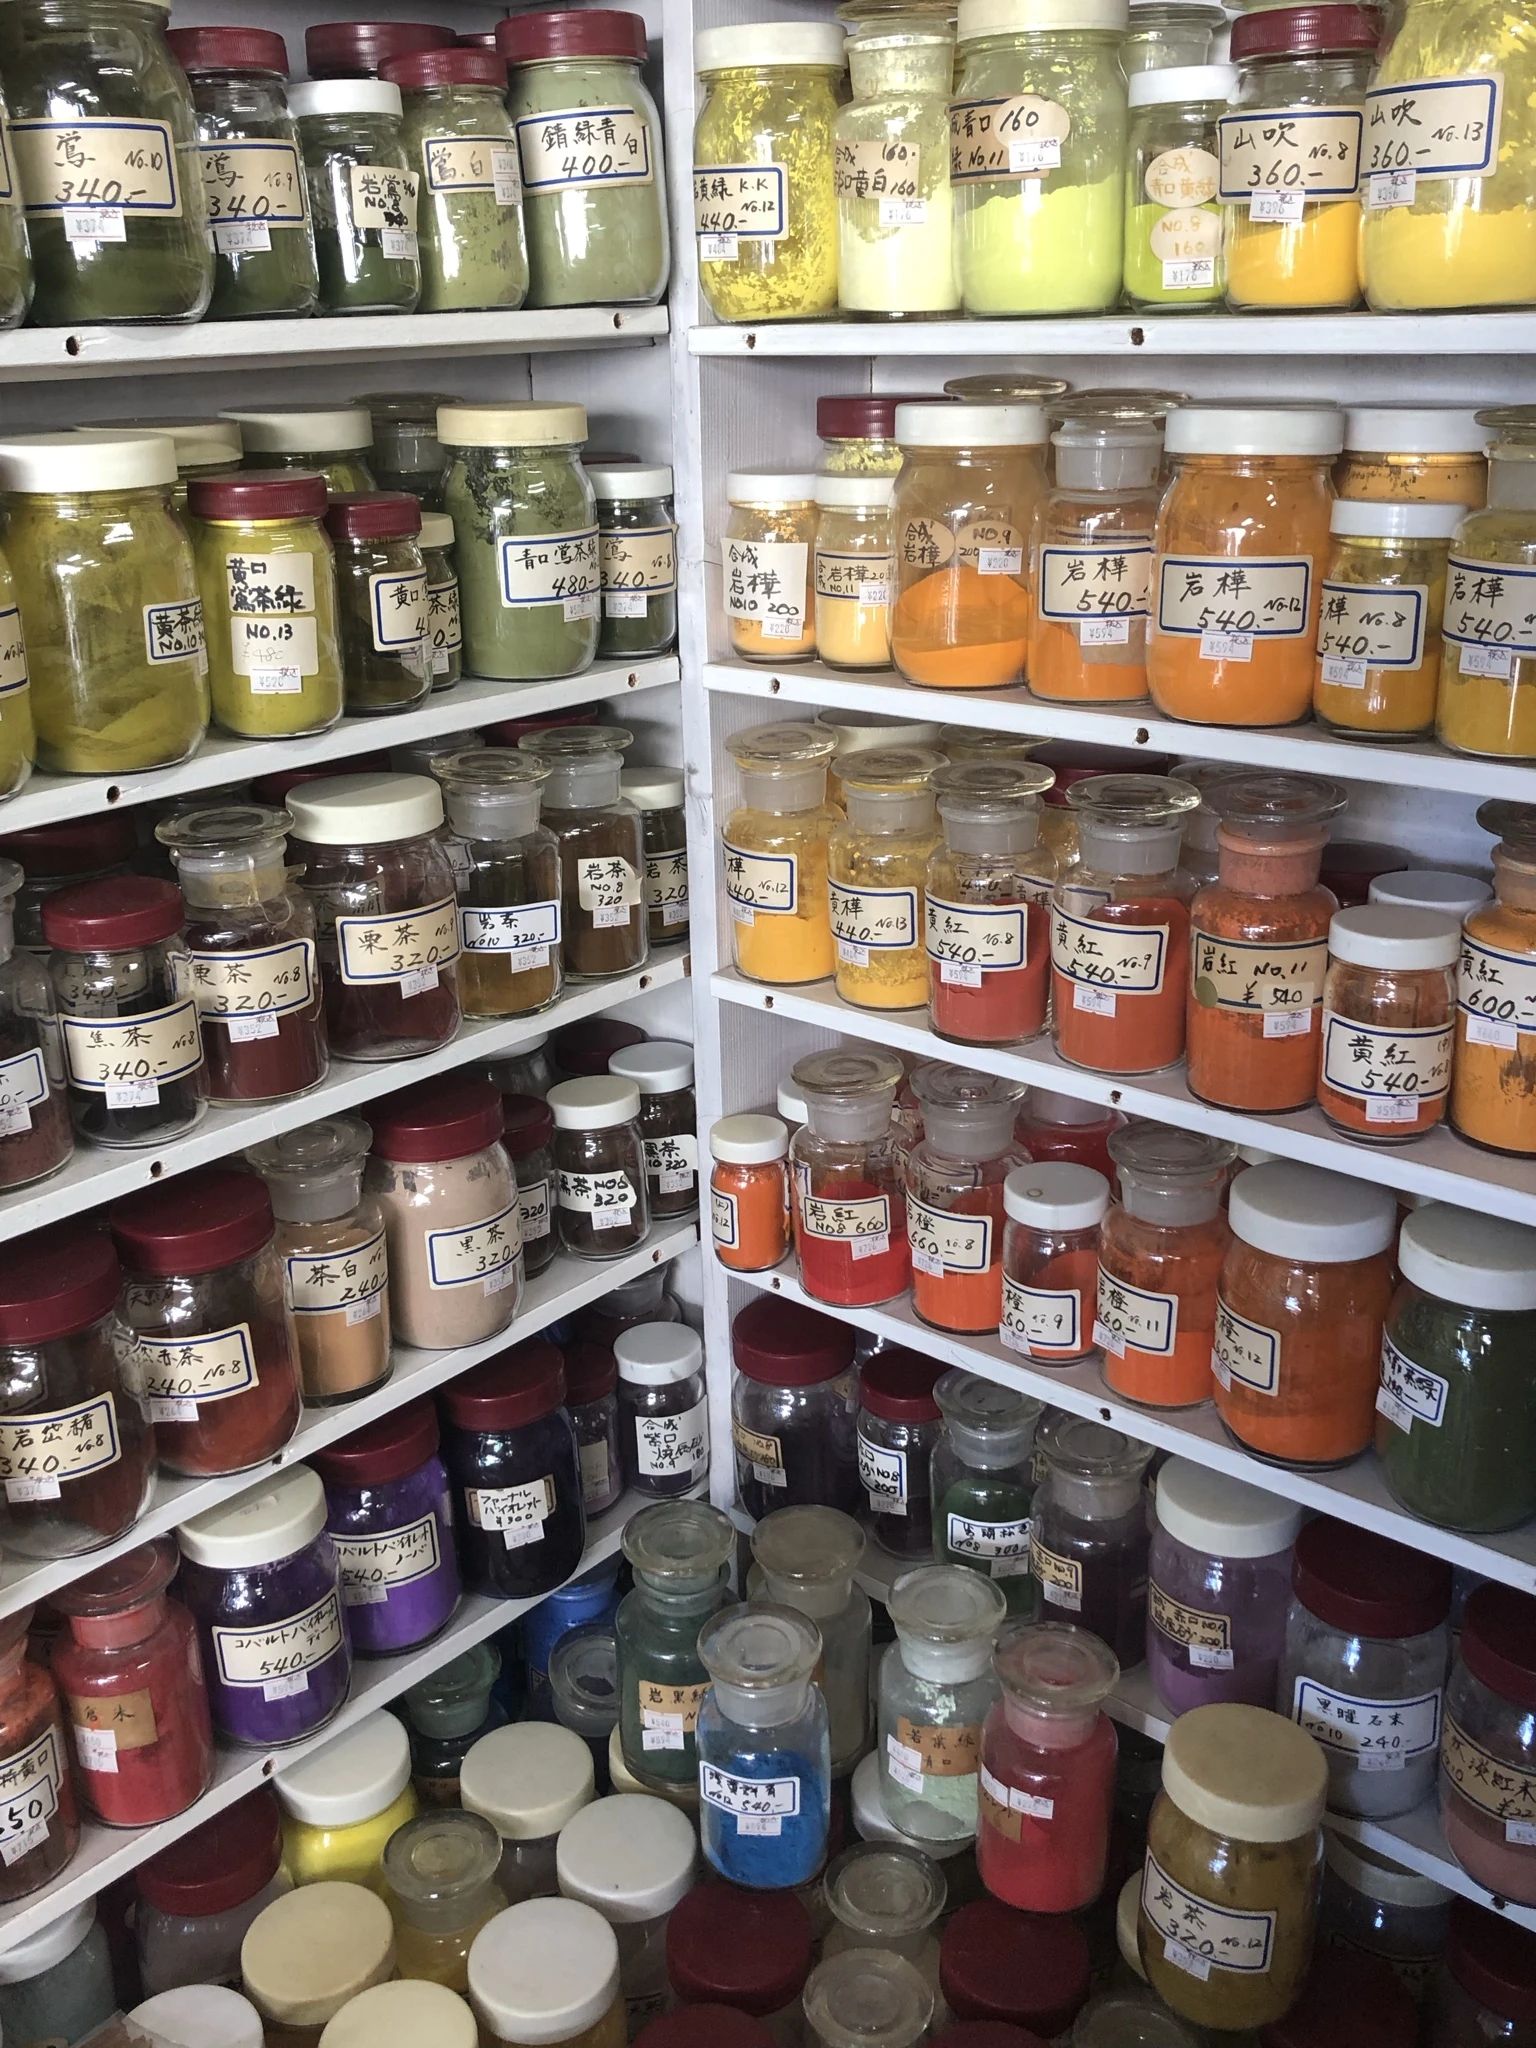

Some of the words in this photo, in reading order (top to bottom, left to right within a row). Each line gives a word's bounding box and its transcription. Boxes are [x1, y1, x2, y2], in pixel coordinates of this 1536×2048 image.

[999, 105, 1040, 132] 160
[1370, 98, 1422, 128] 山吹
[1233, 122, 1300, 151] 山吹
[767, 602, 800, 617] 200
[597, 894, 623, 906] 320
